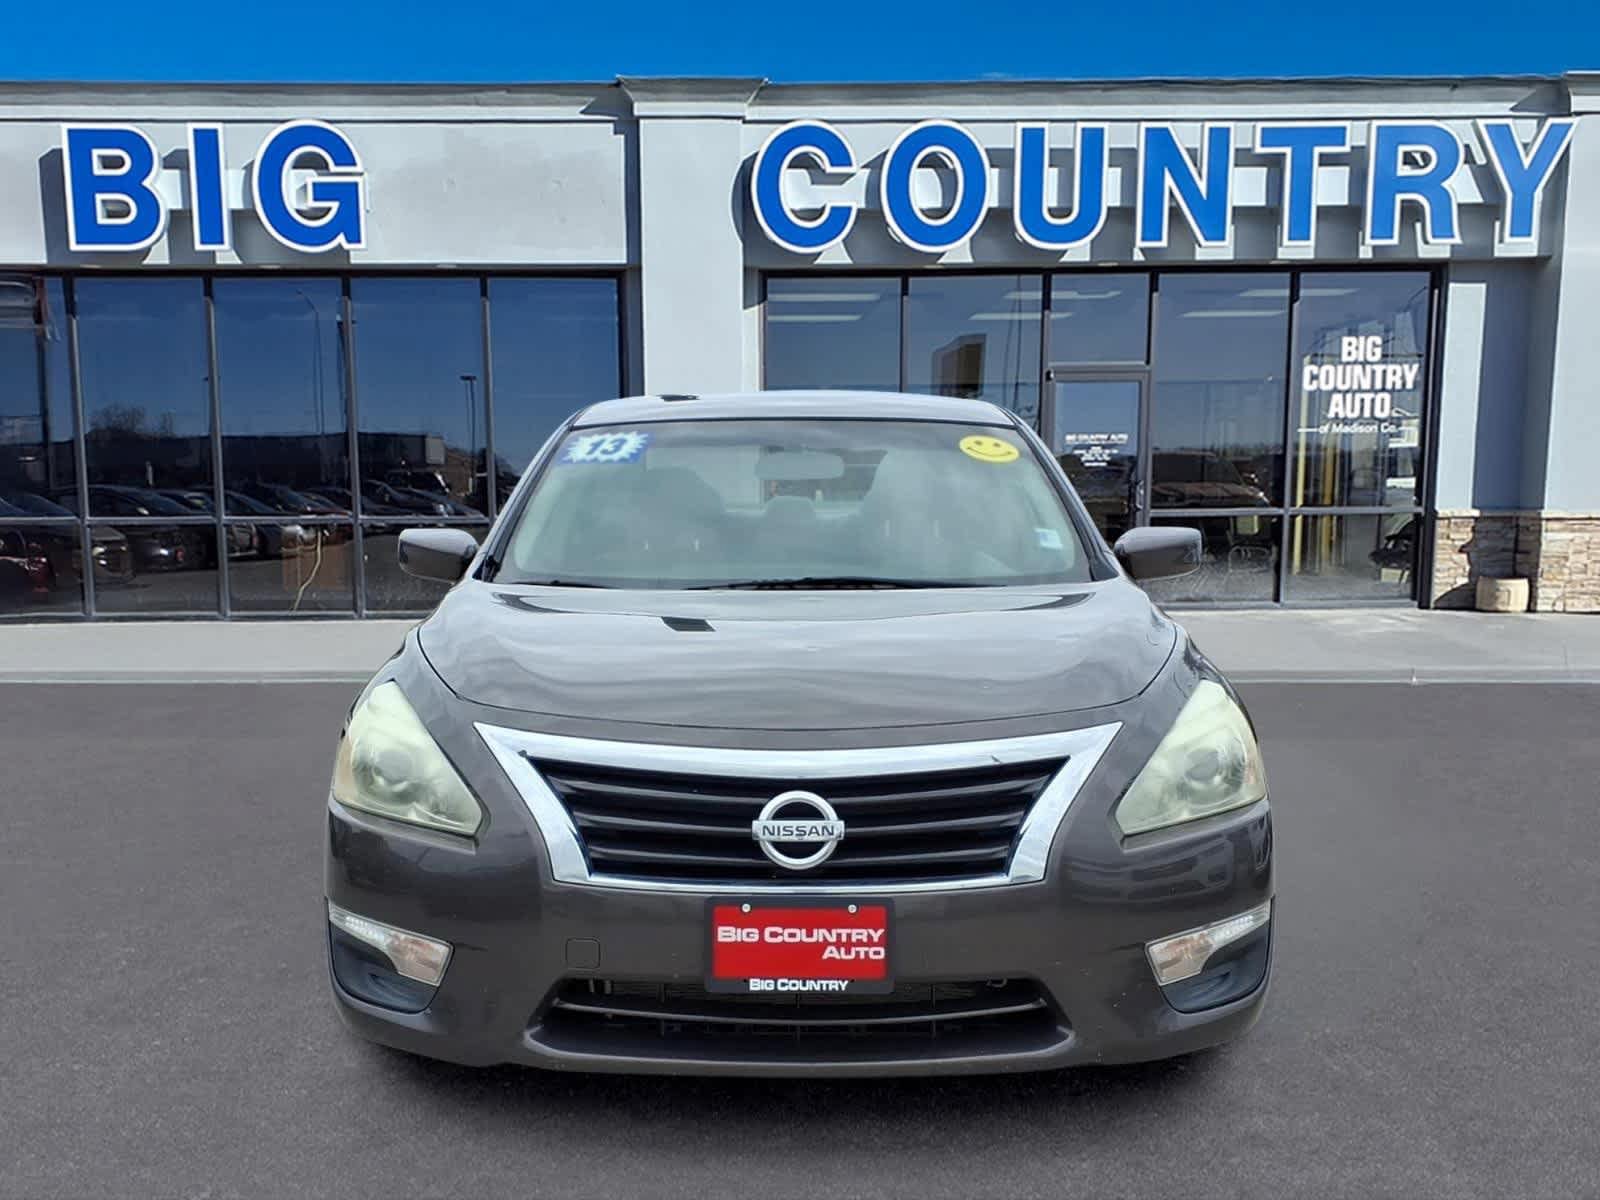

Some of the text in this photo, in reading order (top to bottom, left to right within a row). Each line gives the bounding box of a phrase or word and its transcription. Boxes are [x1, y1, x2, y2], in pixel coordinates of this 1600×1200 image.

[61, 119, 1576, 255] BIG COUNTRY
[1341, 336, 1383, 362] BIG
[1303, 364, 1420, 391] COUNTRY
[1327, 392, 1391, 419] AUTO
[762, 825, 834, 837] NISSAN
[717, 926, 885, 943] BIG COUNTRY
[822, 945, 886, 960] AUTO
[777, 978, 848, 991] COUNTRY
